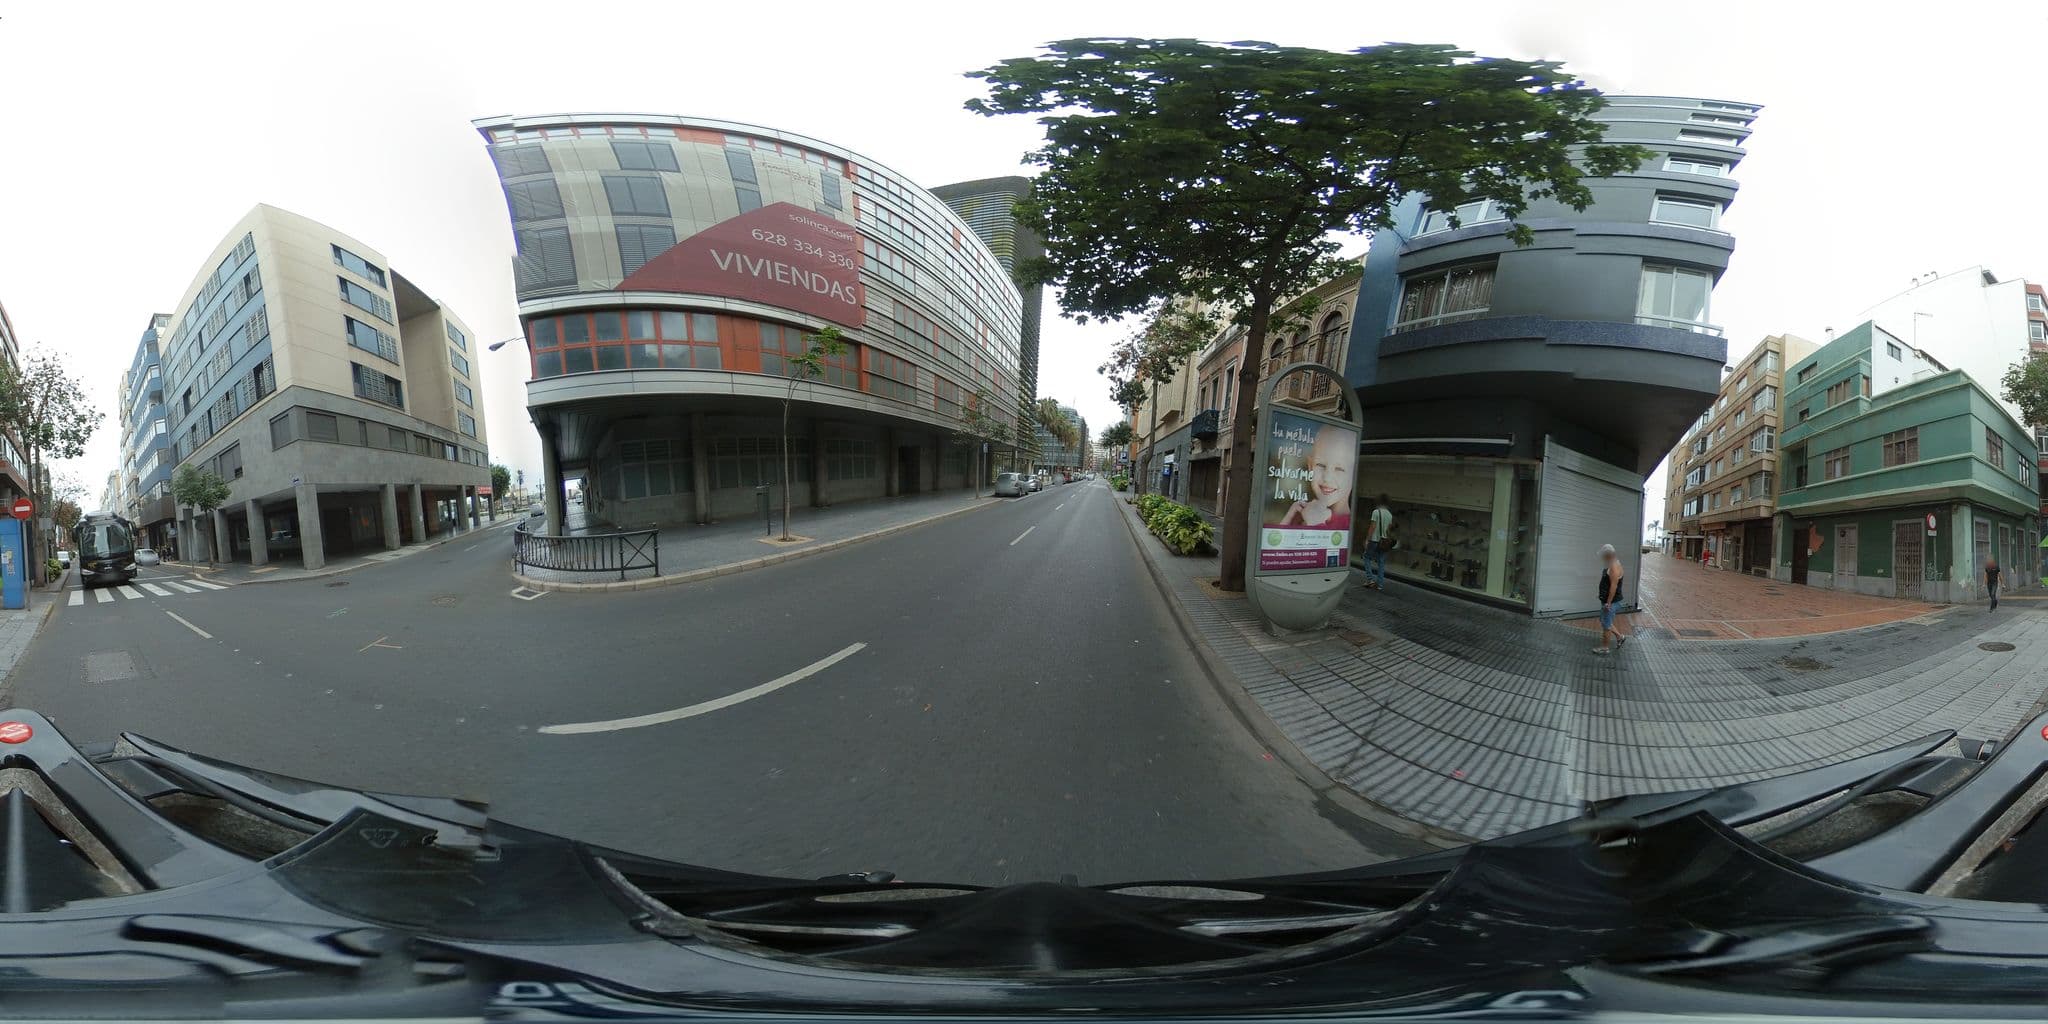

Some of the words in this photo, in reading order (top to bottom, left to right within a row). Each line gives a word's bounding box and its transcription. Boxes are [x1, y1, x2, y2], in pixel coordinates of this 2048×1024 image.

[789, 214, 853, 242] solinca.com
[752, 228, 787, 247] 628
[793, 239, 823, 258] 334
[828, 251, 854, 270] 330
[710, 249, 857, 305] VIVIENDAS
[1272, 422, 1284, 438] tu
[1278, 443, 1302, 459] puede
[1268, 458, 1314, 481] salvarme
[1274, 479, 1285, 499] la
[1288, 484, 1308, 501] vida
